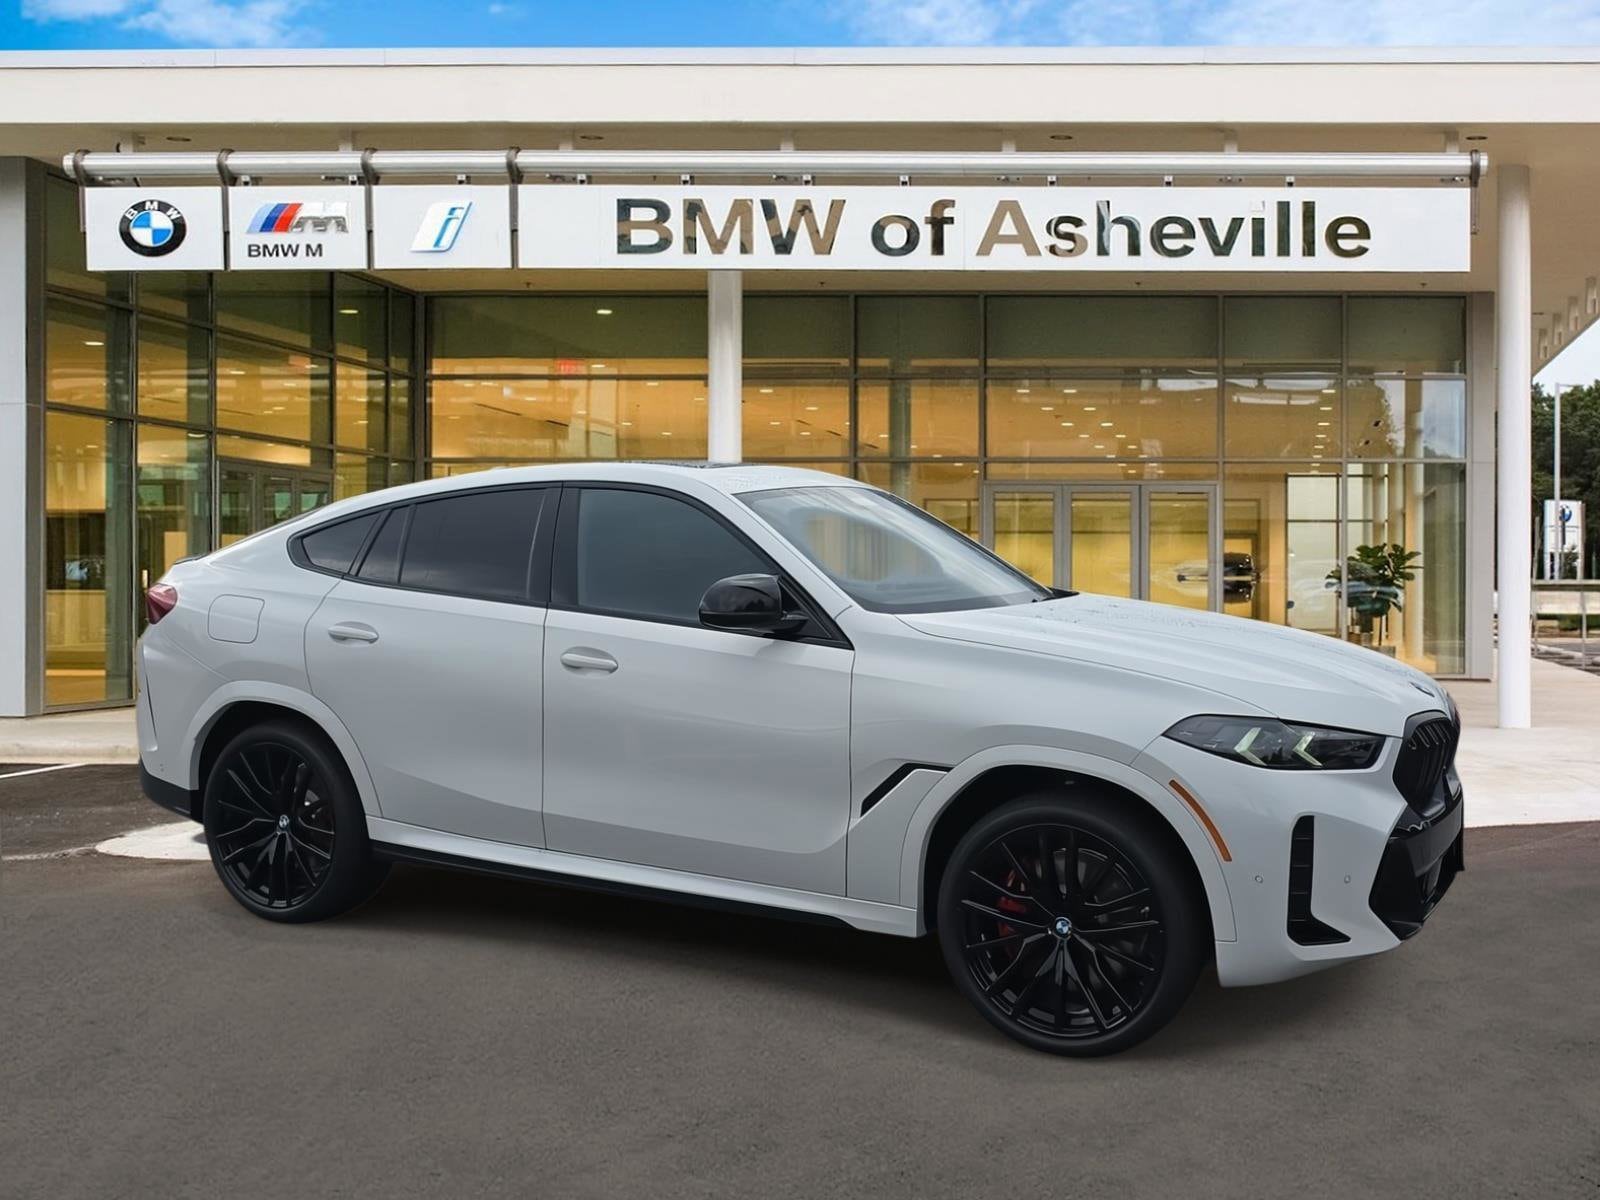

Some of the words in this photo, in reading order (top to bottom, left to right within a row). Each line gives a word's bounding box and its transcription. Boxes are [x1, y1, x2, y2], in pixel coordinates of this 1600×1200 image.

[125, 200, 181, 220] BMW
[616, 198, 847, 256] BMW
[870, 198, 956, 257] of
[975, 199, 1372, 258] Asheville
[247, 243, 300, 258] BMW
[305, 243, 323, 258] M
